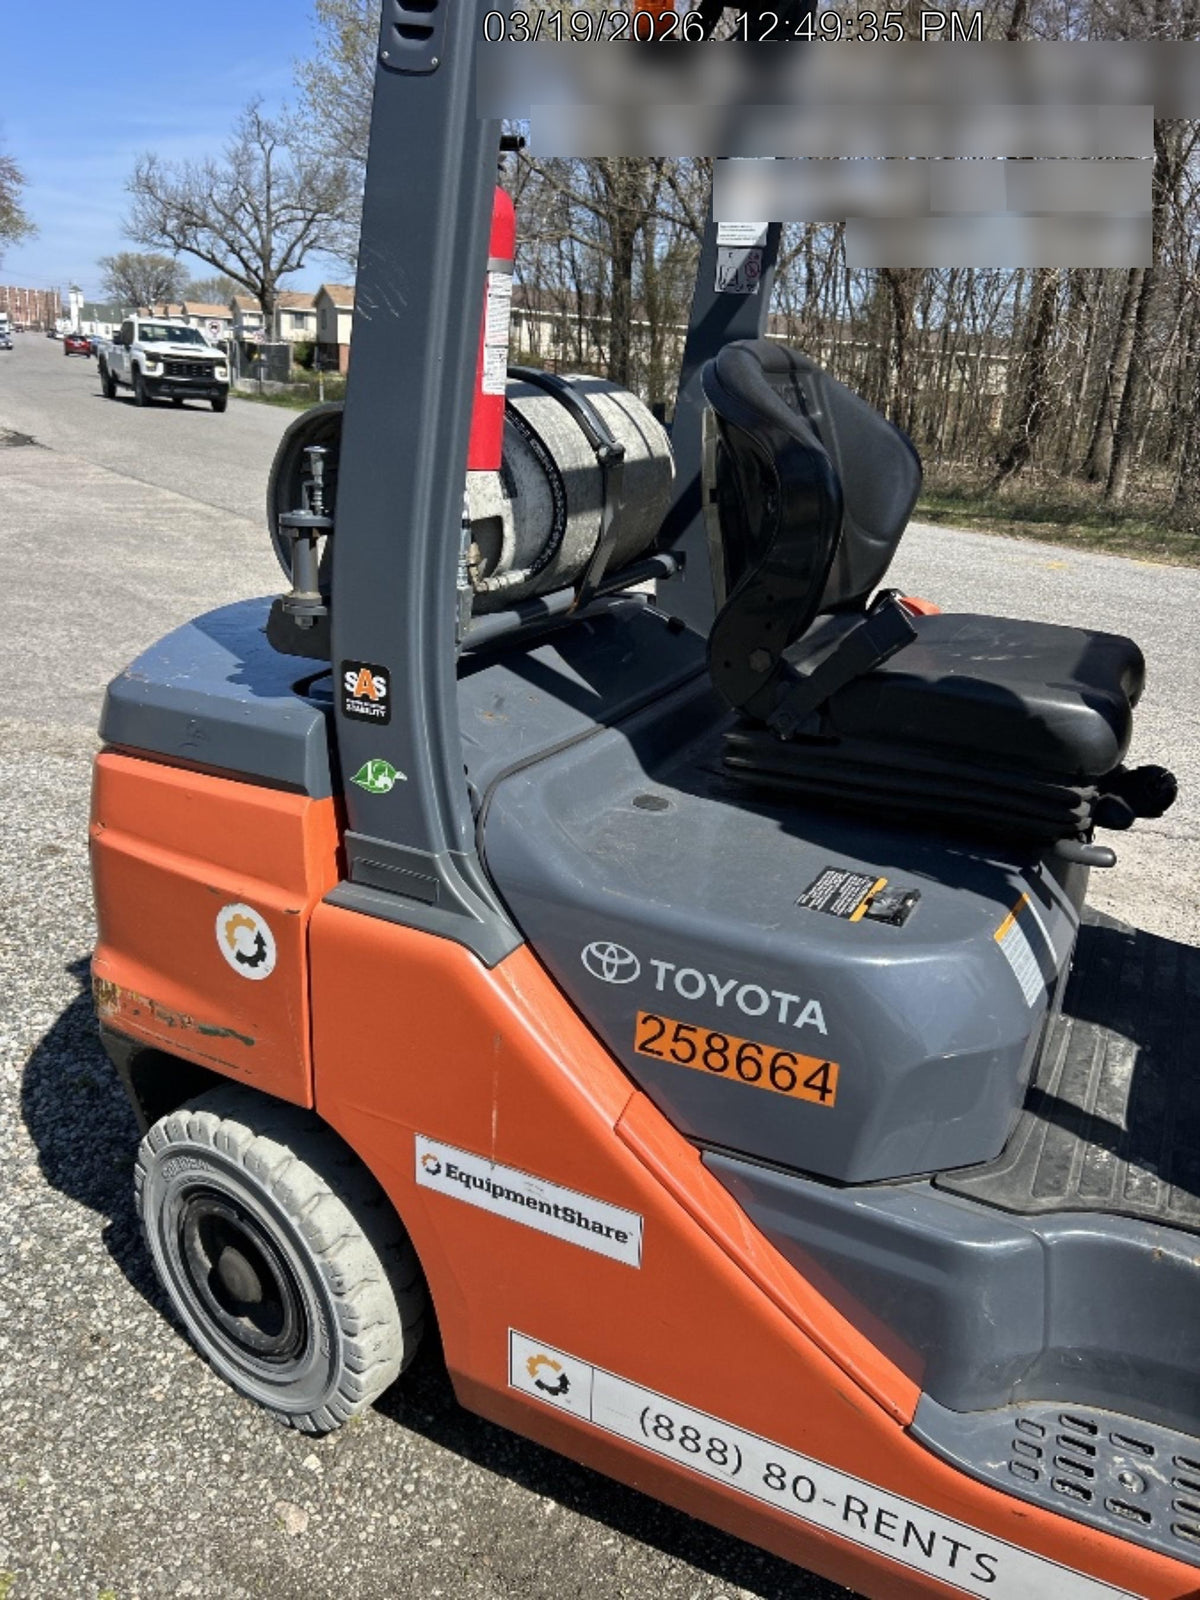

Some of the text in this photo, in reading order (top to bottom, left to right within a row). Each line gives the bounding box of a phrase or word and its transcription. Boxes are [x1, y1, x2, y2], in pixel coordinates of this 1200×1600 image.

[345, 668, 387, 700] SAS
[650, 958, 828, 1035] TOYOTA
[637, 1014, 832, 1101] 258664
[445, 1161, 629, 1244] EquipmentShare
[640, 1406, 998, 1583] (888) 80-RENTS
